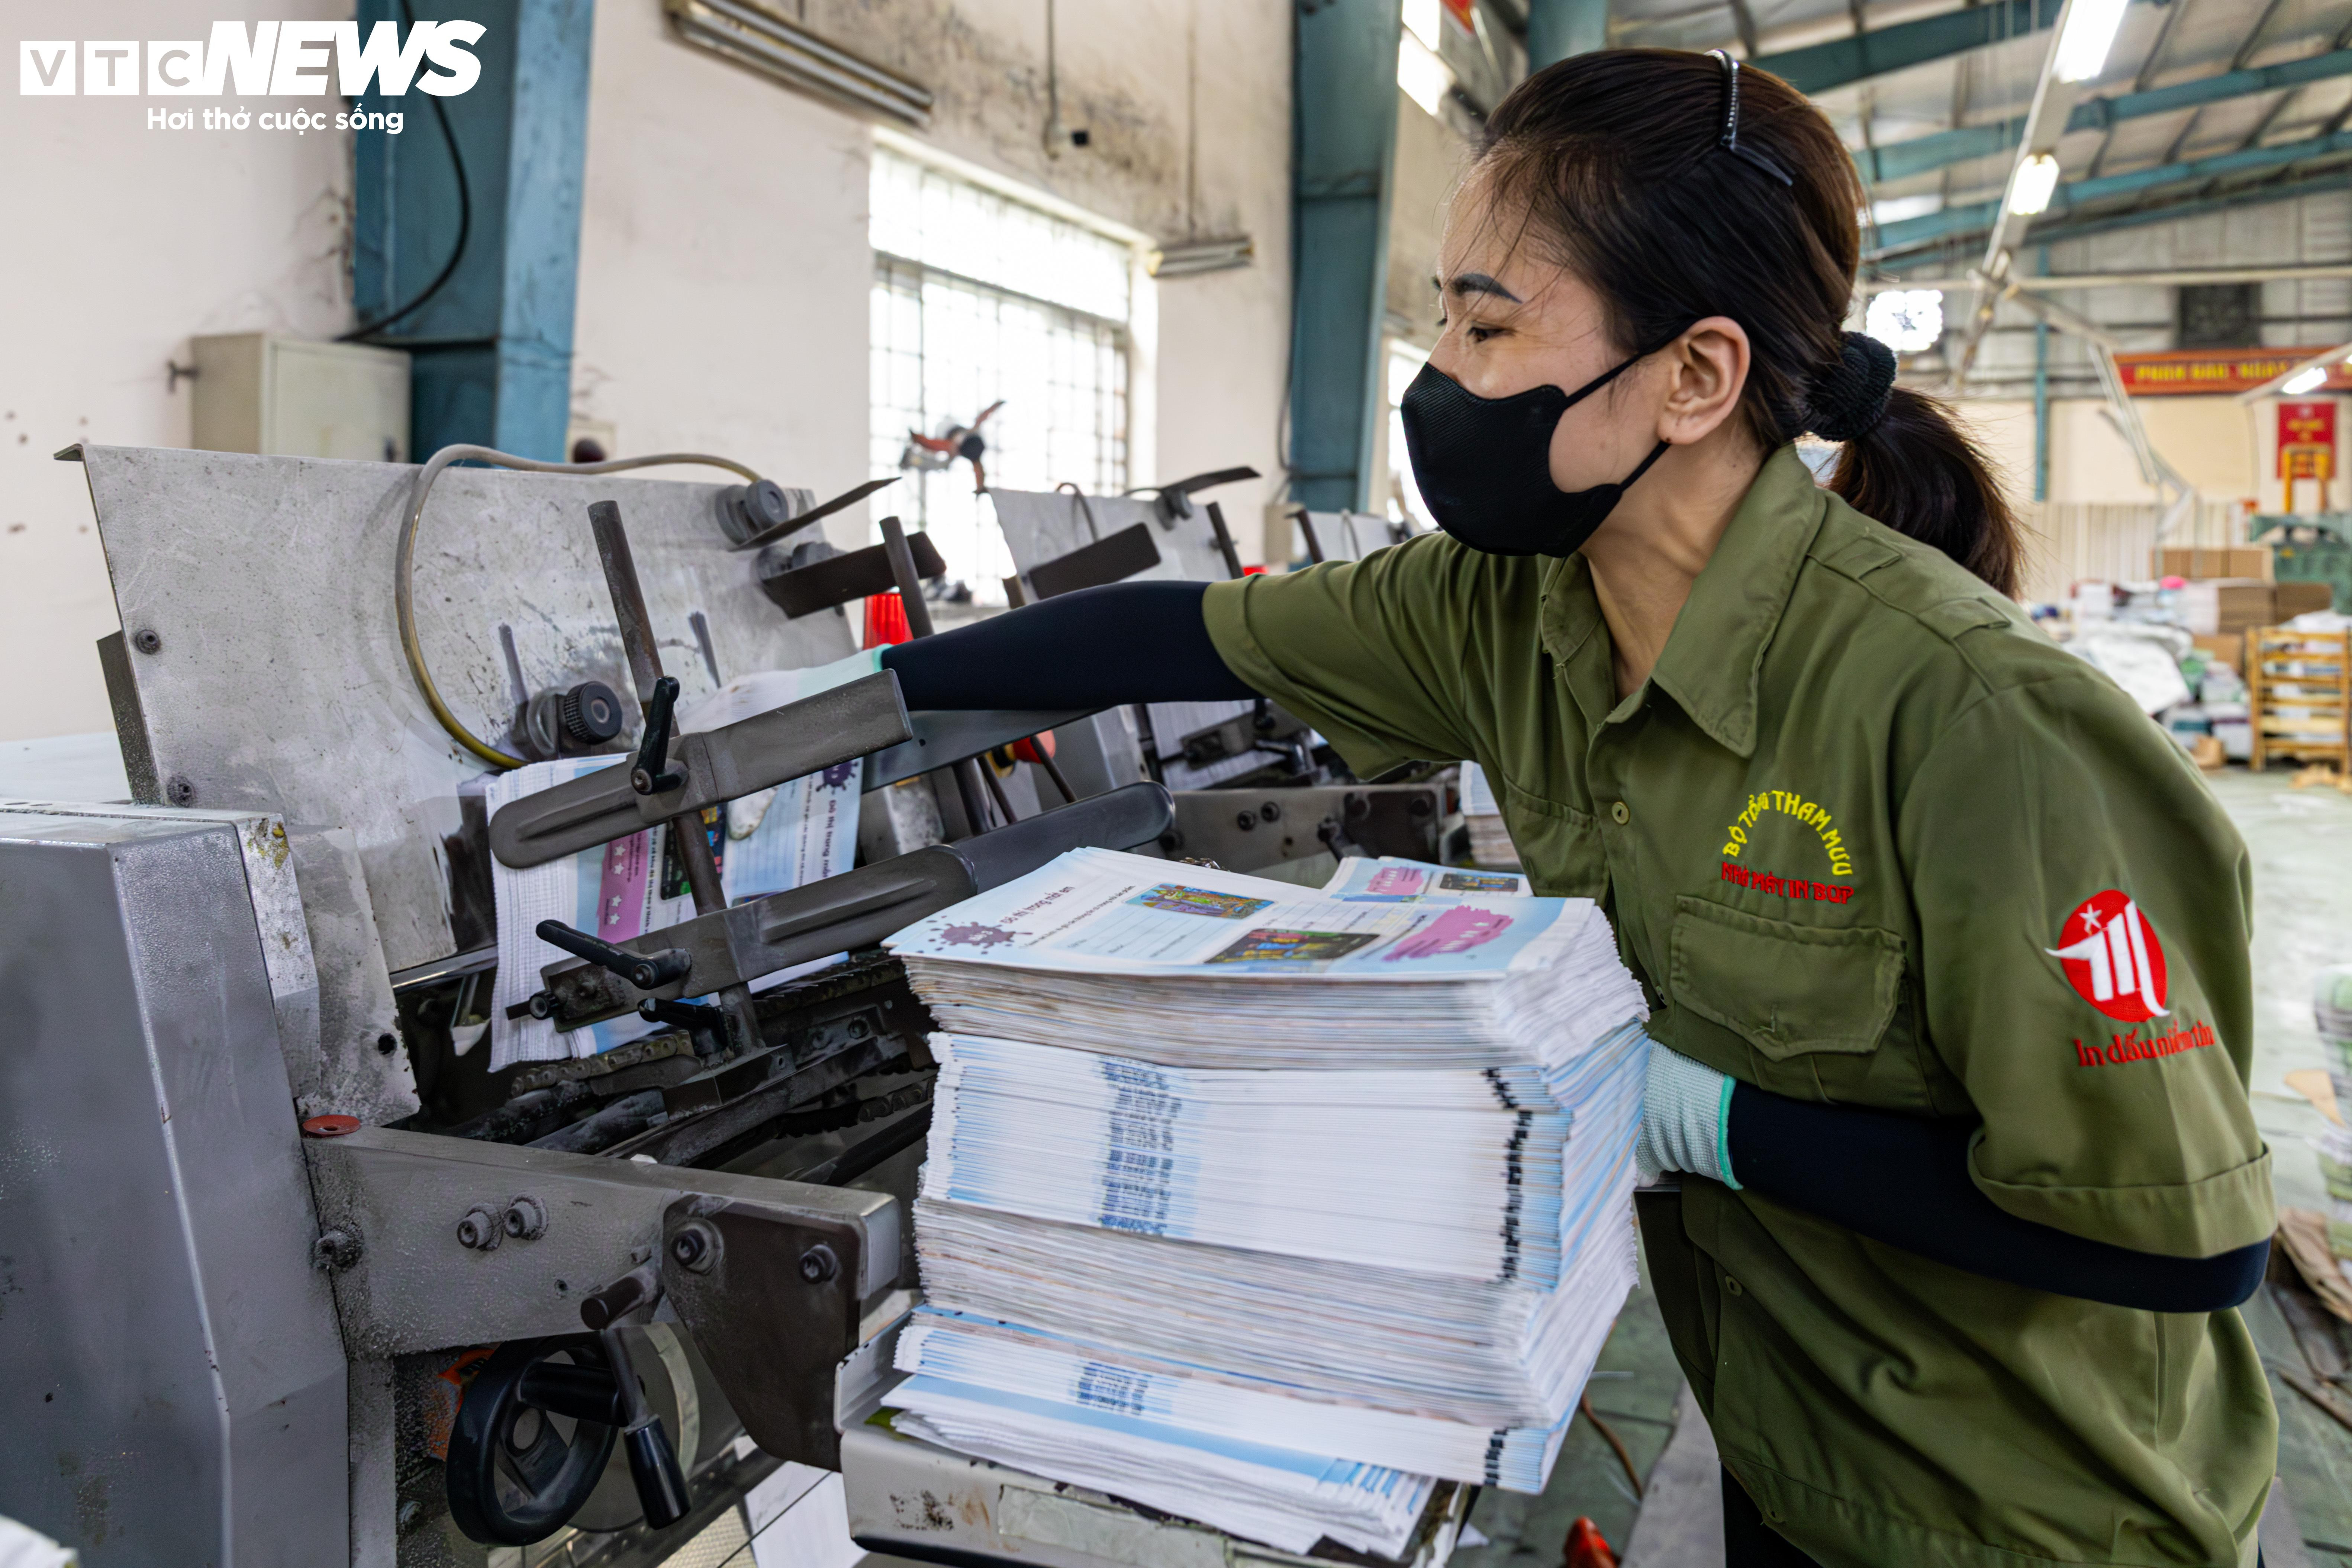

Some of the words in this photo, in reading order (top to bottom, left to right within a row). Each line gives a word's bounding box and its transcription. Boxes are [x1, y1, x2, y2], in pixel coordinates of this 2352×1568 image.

[1771, 790, 1832, 831] THAM
[1752, 870, 1786, 897] MÁY
[1788, 879, 1809, 899] IN
[2073, 1039, 2105, 1067] In
